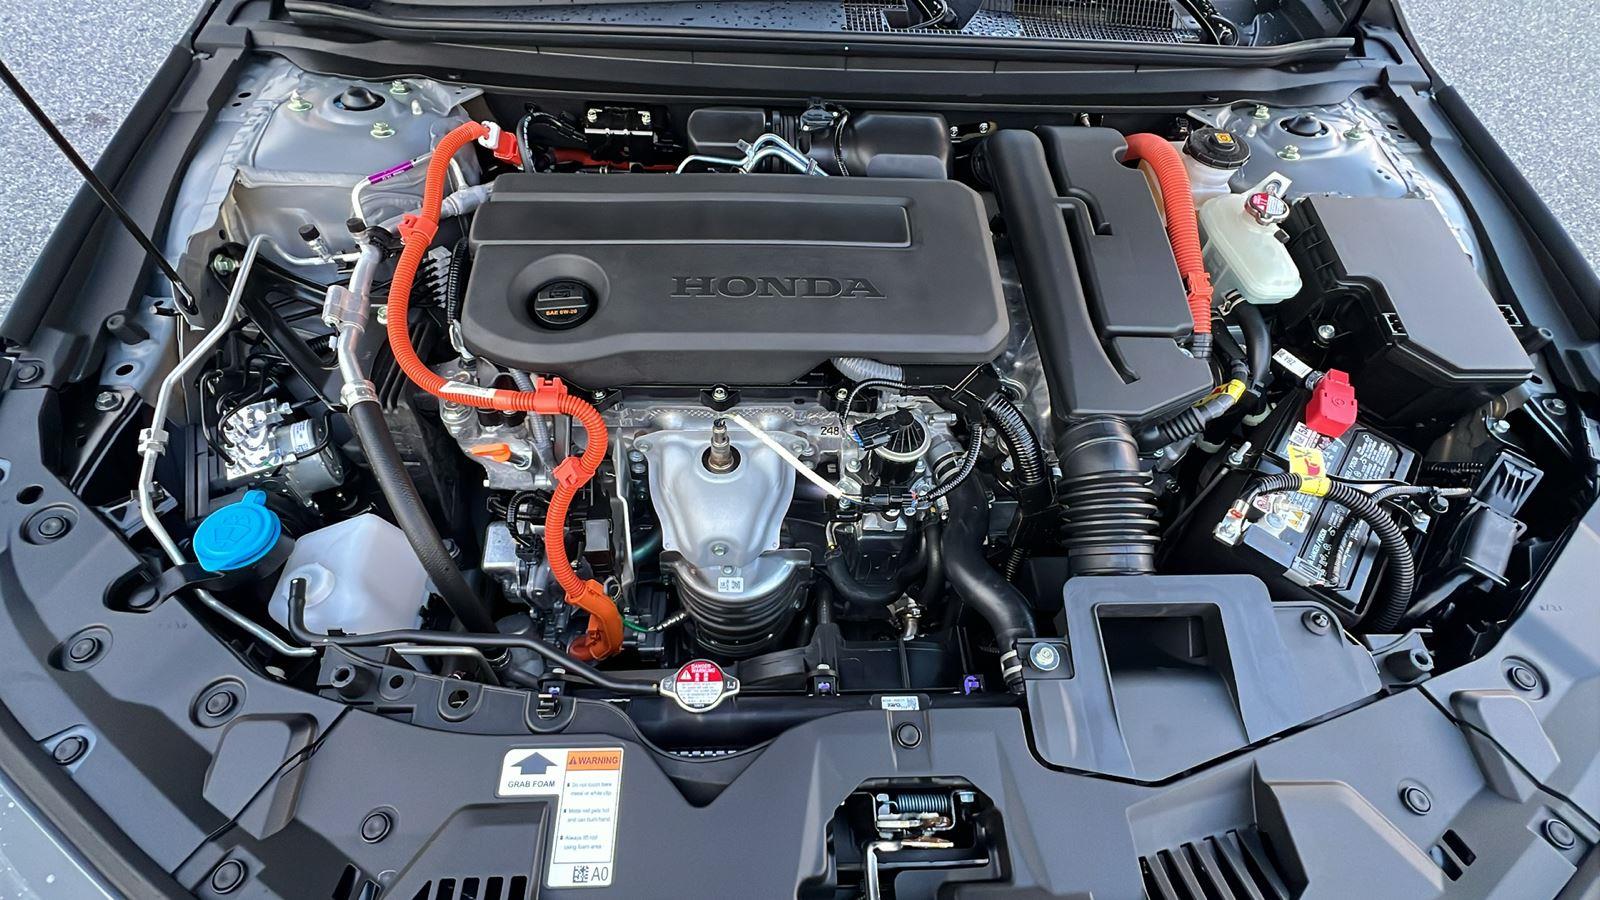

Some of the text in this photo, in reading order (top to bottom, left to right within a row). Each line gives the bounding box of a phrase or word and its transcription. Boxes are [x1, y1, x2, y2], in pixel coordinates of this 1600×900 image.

[670, 276, 887, 299] HONDA
[821, 427, 839, 435] 248
[578, 756, 618, 765] WARNING
[532, 780, 555, 788] FOAM
